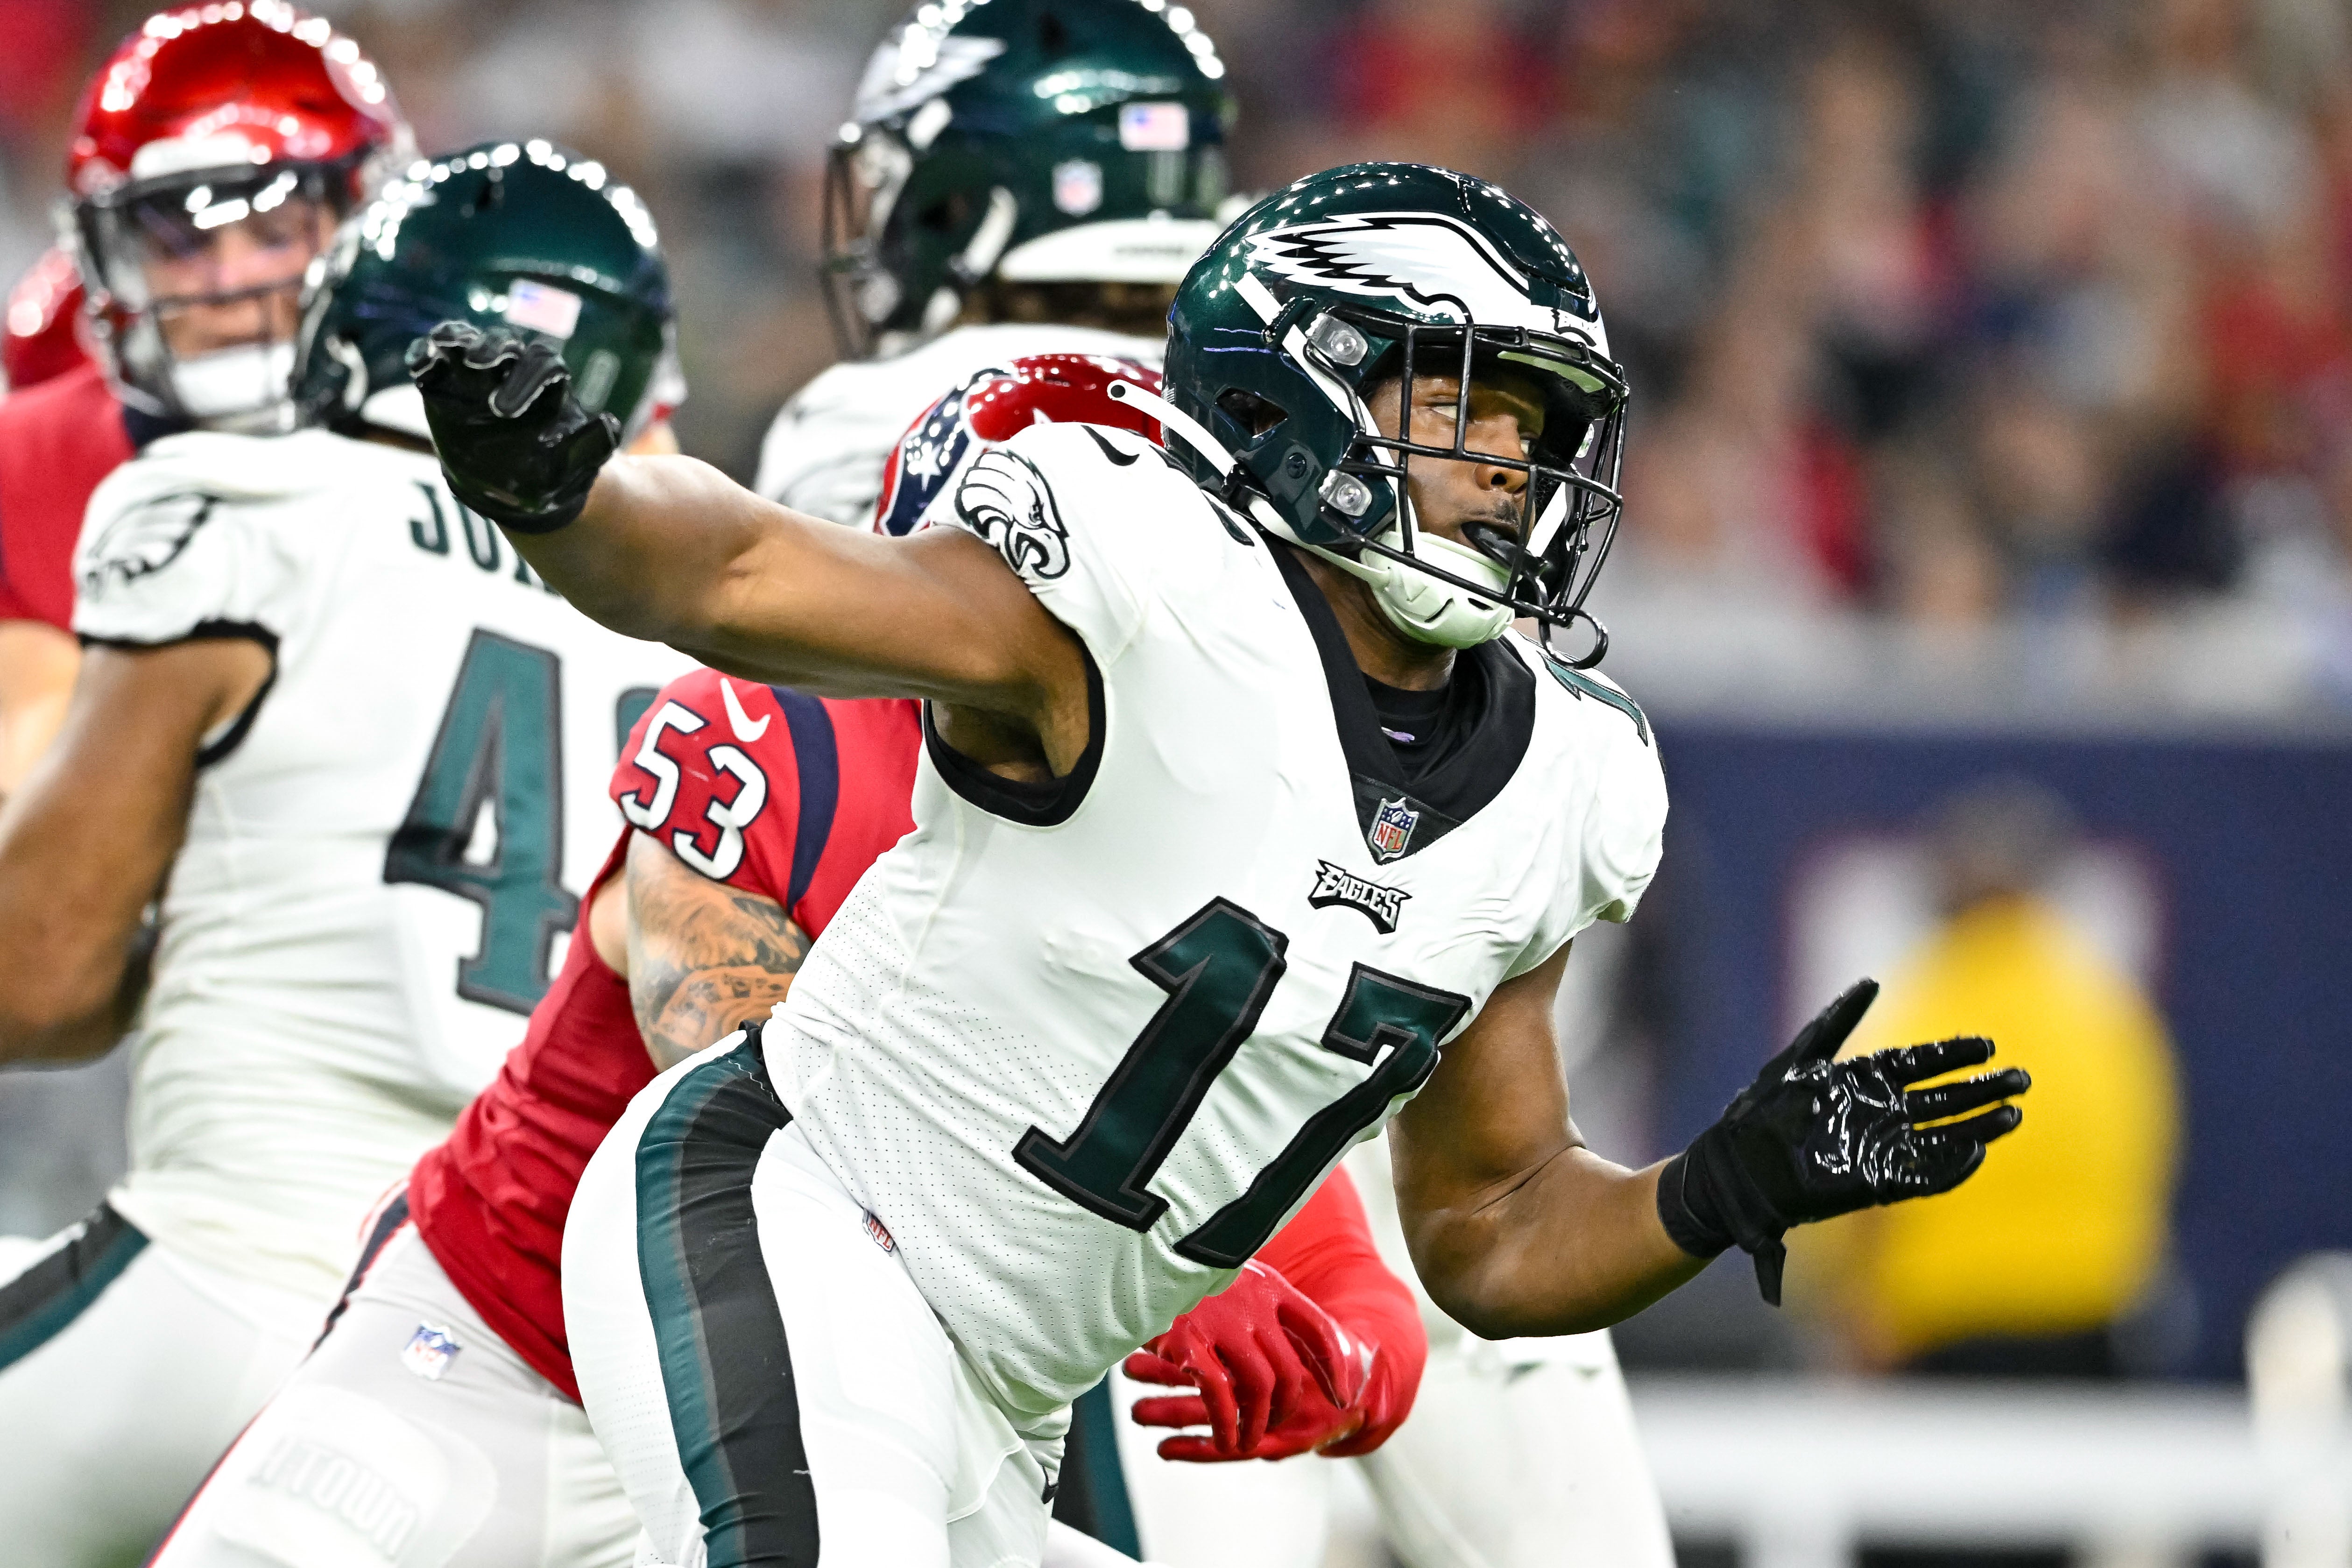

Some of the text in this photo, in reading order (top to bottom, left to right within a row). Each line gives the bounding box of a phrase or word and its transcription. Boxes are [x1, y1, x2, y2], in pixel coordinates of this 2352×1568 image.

[410, 480, 564, 598] JO
[382, 627, 662, 1018] 4
[620, 699, 770, 882] 53
[1375, 822, 1404, 851] NFL
[1308, 860, 1412, 933] EAGLES
[1011, 895, 1473, 1270] 17
[868, 1217, 892, 1250] NFL
